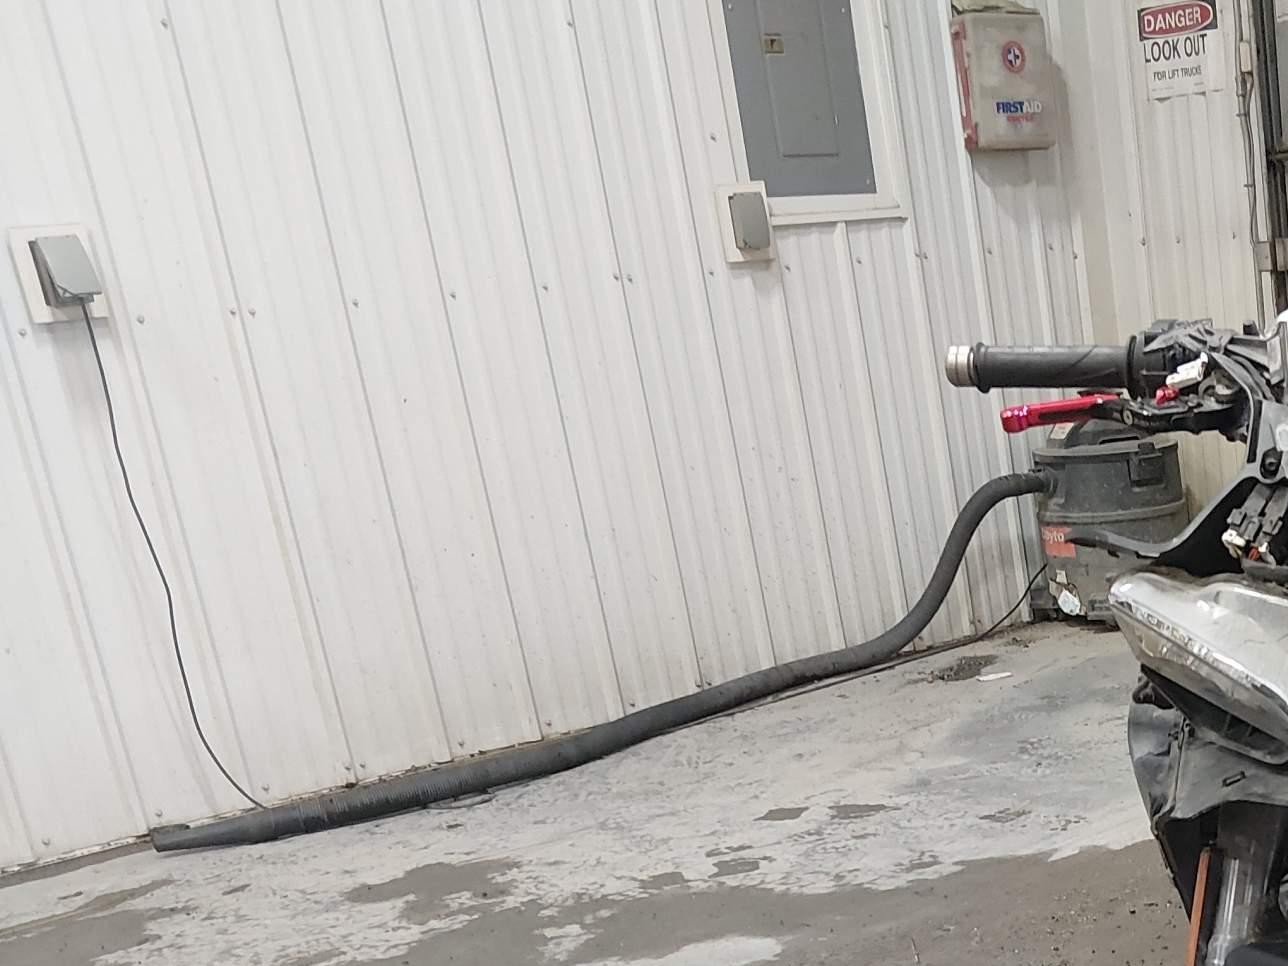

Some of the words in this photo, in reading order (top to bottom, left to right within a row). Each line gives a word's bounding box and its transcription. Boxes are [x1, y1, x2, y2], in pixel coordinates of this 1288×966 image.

[1144, 6, 1202, 32] DANGER
[1143, 37, 1181, 63] LOOK
[1184, 33, 1207, 57] OUT
[1167, 68, 1180, 79] LIFT
[1180, 65, 1202, 77] TRUCKS
